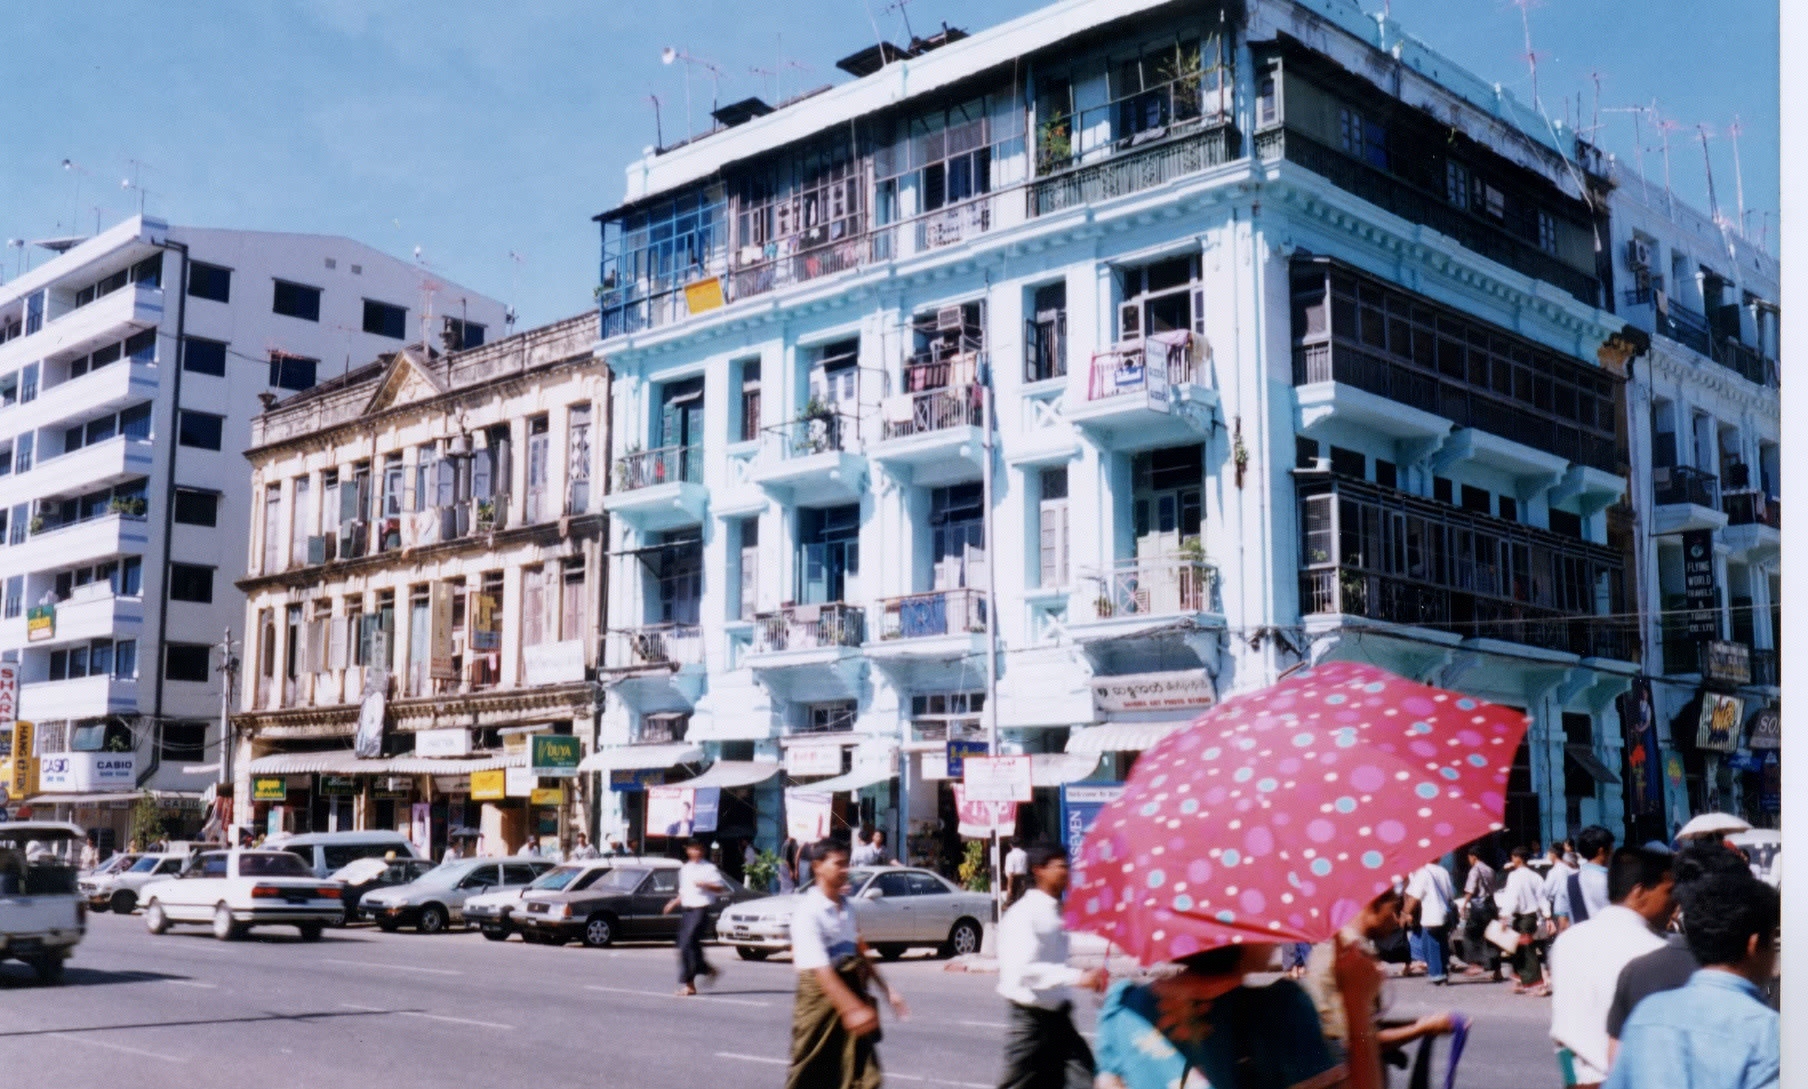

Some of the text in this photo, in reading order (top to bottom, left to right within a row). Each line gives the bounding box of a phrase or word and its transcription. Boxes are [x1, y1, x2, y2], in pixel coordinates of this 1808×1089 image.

[1687, 561, 1709, 572] FLYING
[1688, 576, 1711, 586] WORLD
[1758, 715, 1781, 734] SO
[42, 758, 70, 773] CASIO
[97, 760, 133, 770] CASIO
